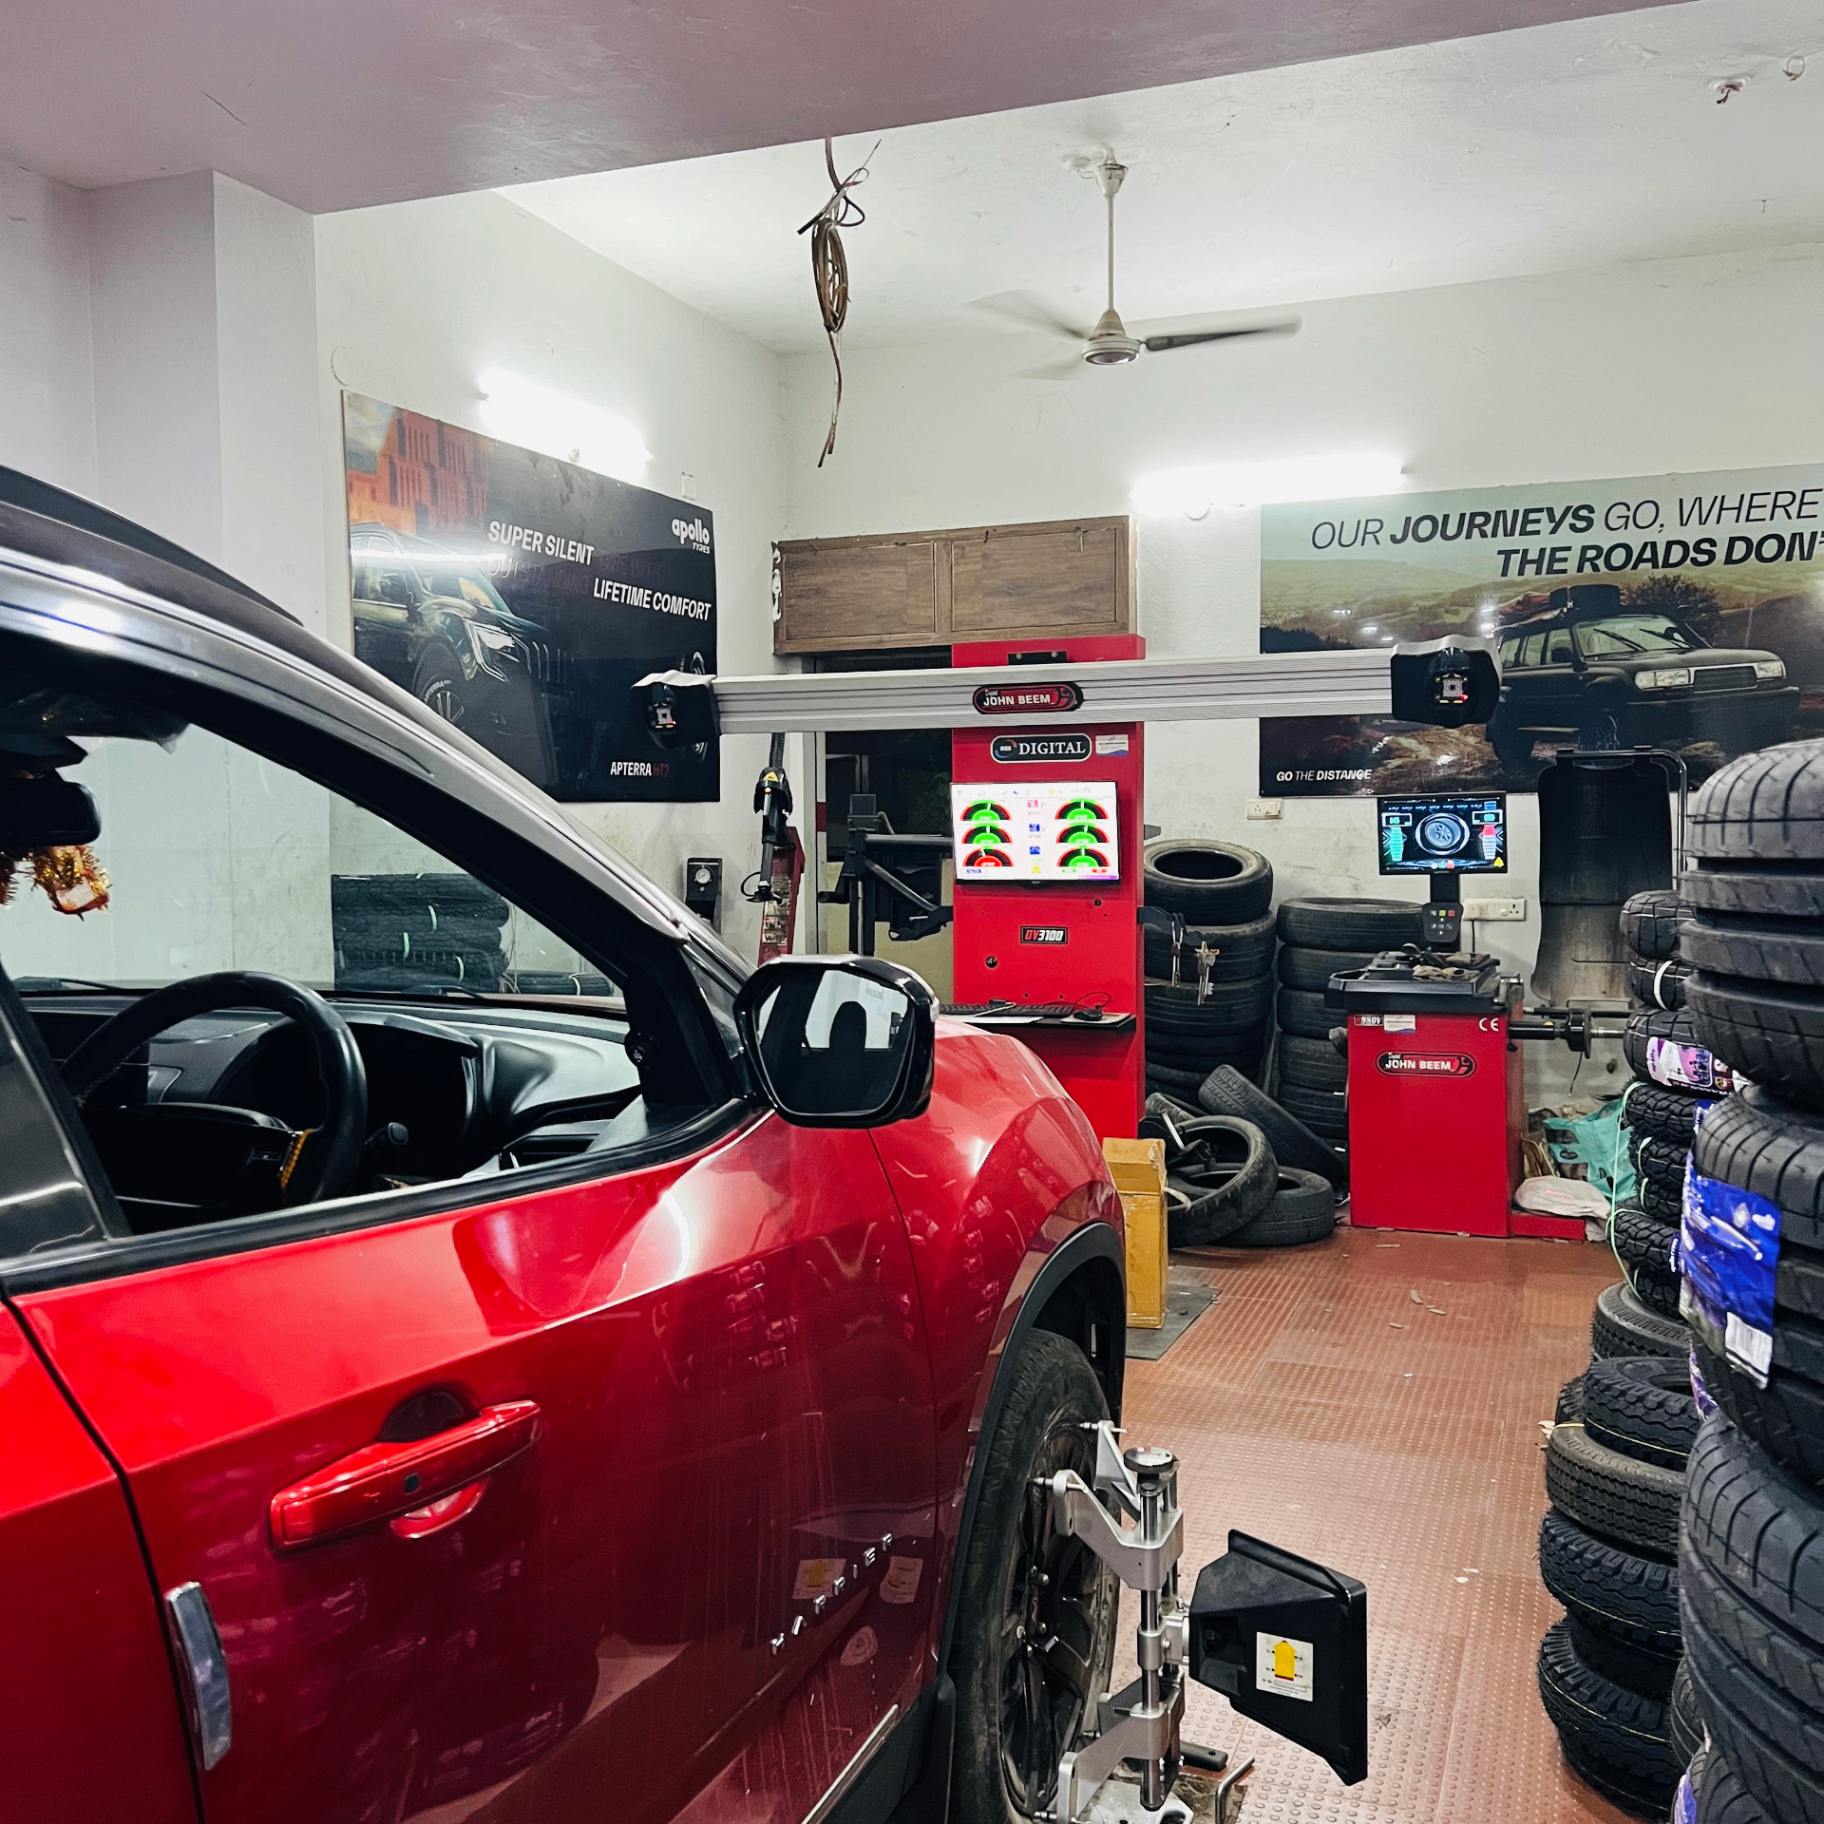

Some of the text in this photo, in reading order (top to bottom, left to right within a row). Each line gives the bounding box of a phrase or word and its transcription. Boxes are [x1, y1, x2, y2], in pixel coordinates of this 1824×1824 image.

[1311, 487, 1824, 550] OUR JOURNEYS GO, WHERE
[671, 517, 711, 545] apollo
[488, 520, 595, 566] SUPER SILENT
[693, 541, 711, 555] TYRES
[1496, 530, 1824, 578] THE ROADS DON'
[593, 577, 712, 621] LIFETIME COMFORT
[983, 694, 1051, 707] JOHN BEEM
[1018, 741, 1087, 755] DIGITAL
[610, 761, 653, 776] APTERRA
[1276, 768, 1373, 782] GO THE DISTANCE
[1385, 1059, 1452, 1071] JOHN BEEM
